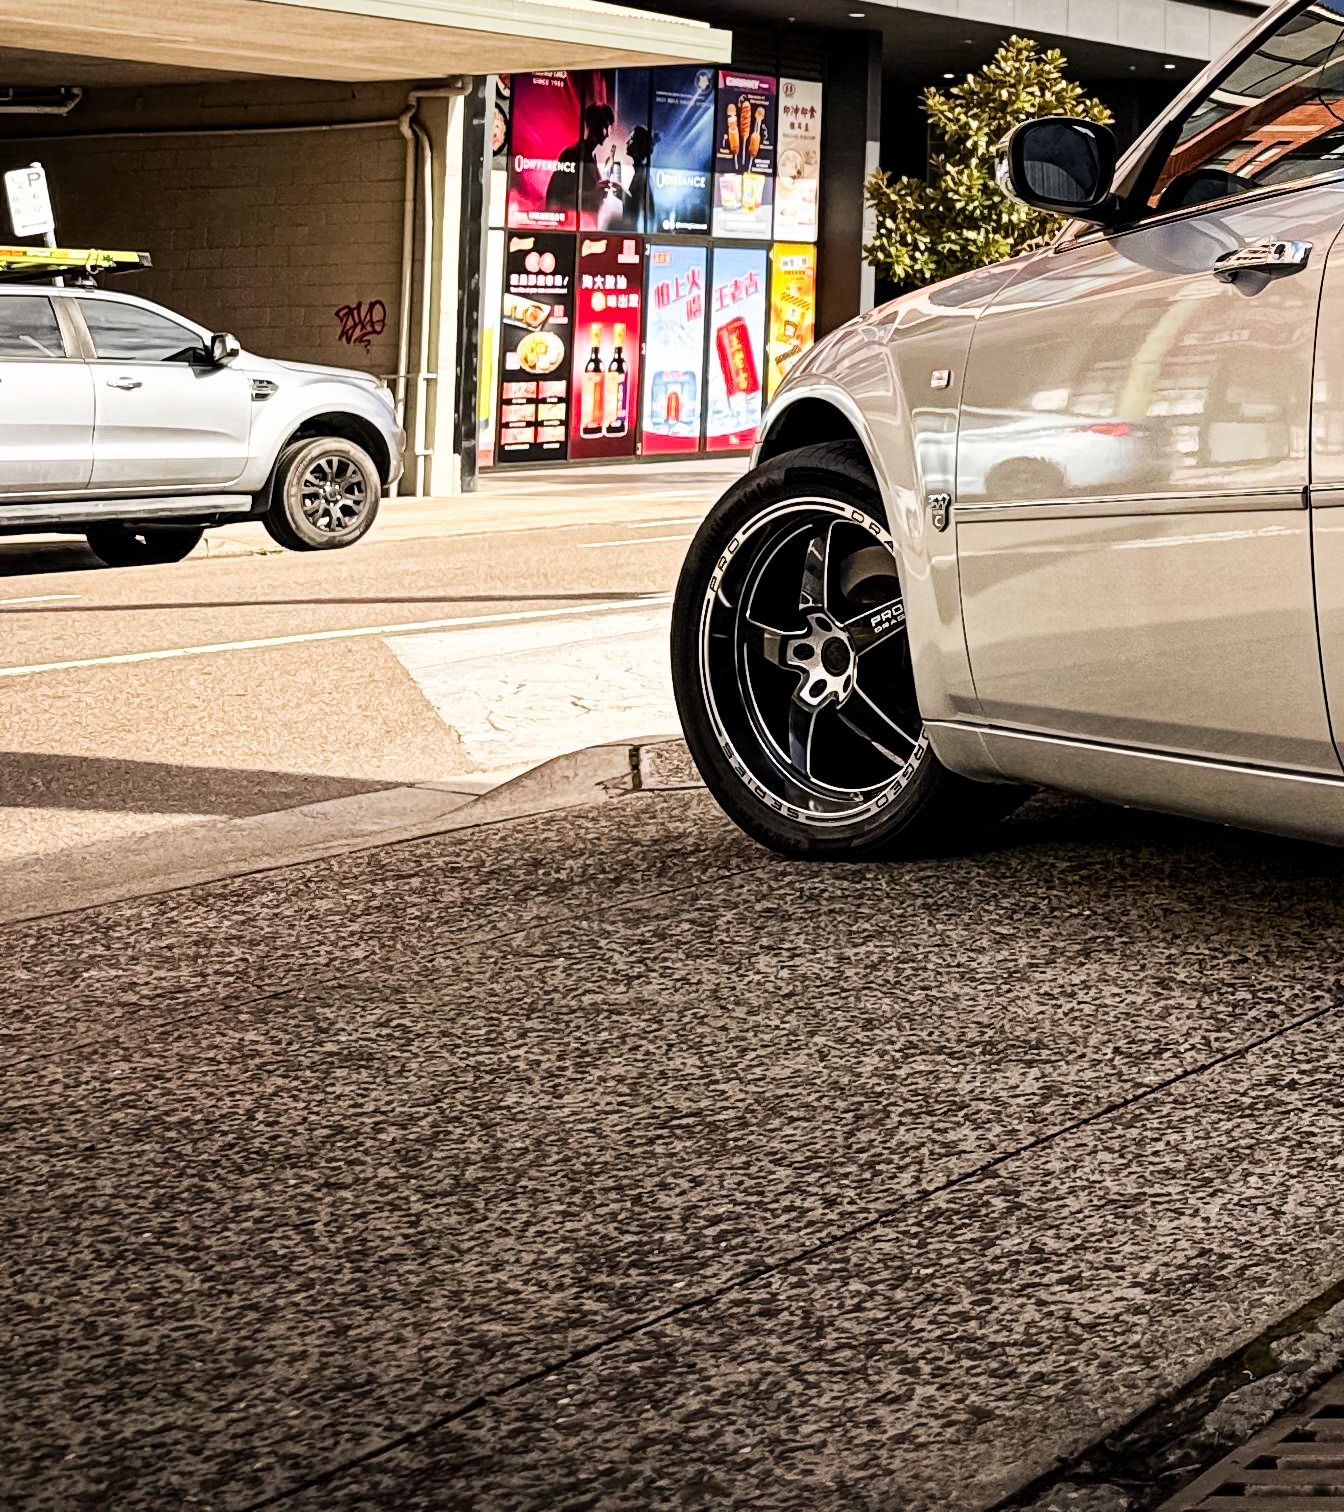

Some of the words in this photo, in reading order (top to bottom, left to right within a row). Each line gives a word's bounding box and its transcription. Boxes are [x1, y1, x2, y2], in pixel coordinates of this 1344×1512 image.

[851, 509, 894, 553] DRA
[709, 538, 740, 593] PRO
[870, 603, 904, 627] PRO
[722, 742, 800, 820] SERIES
